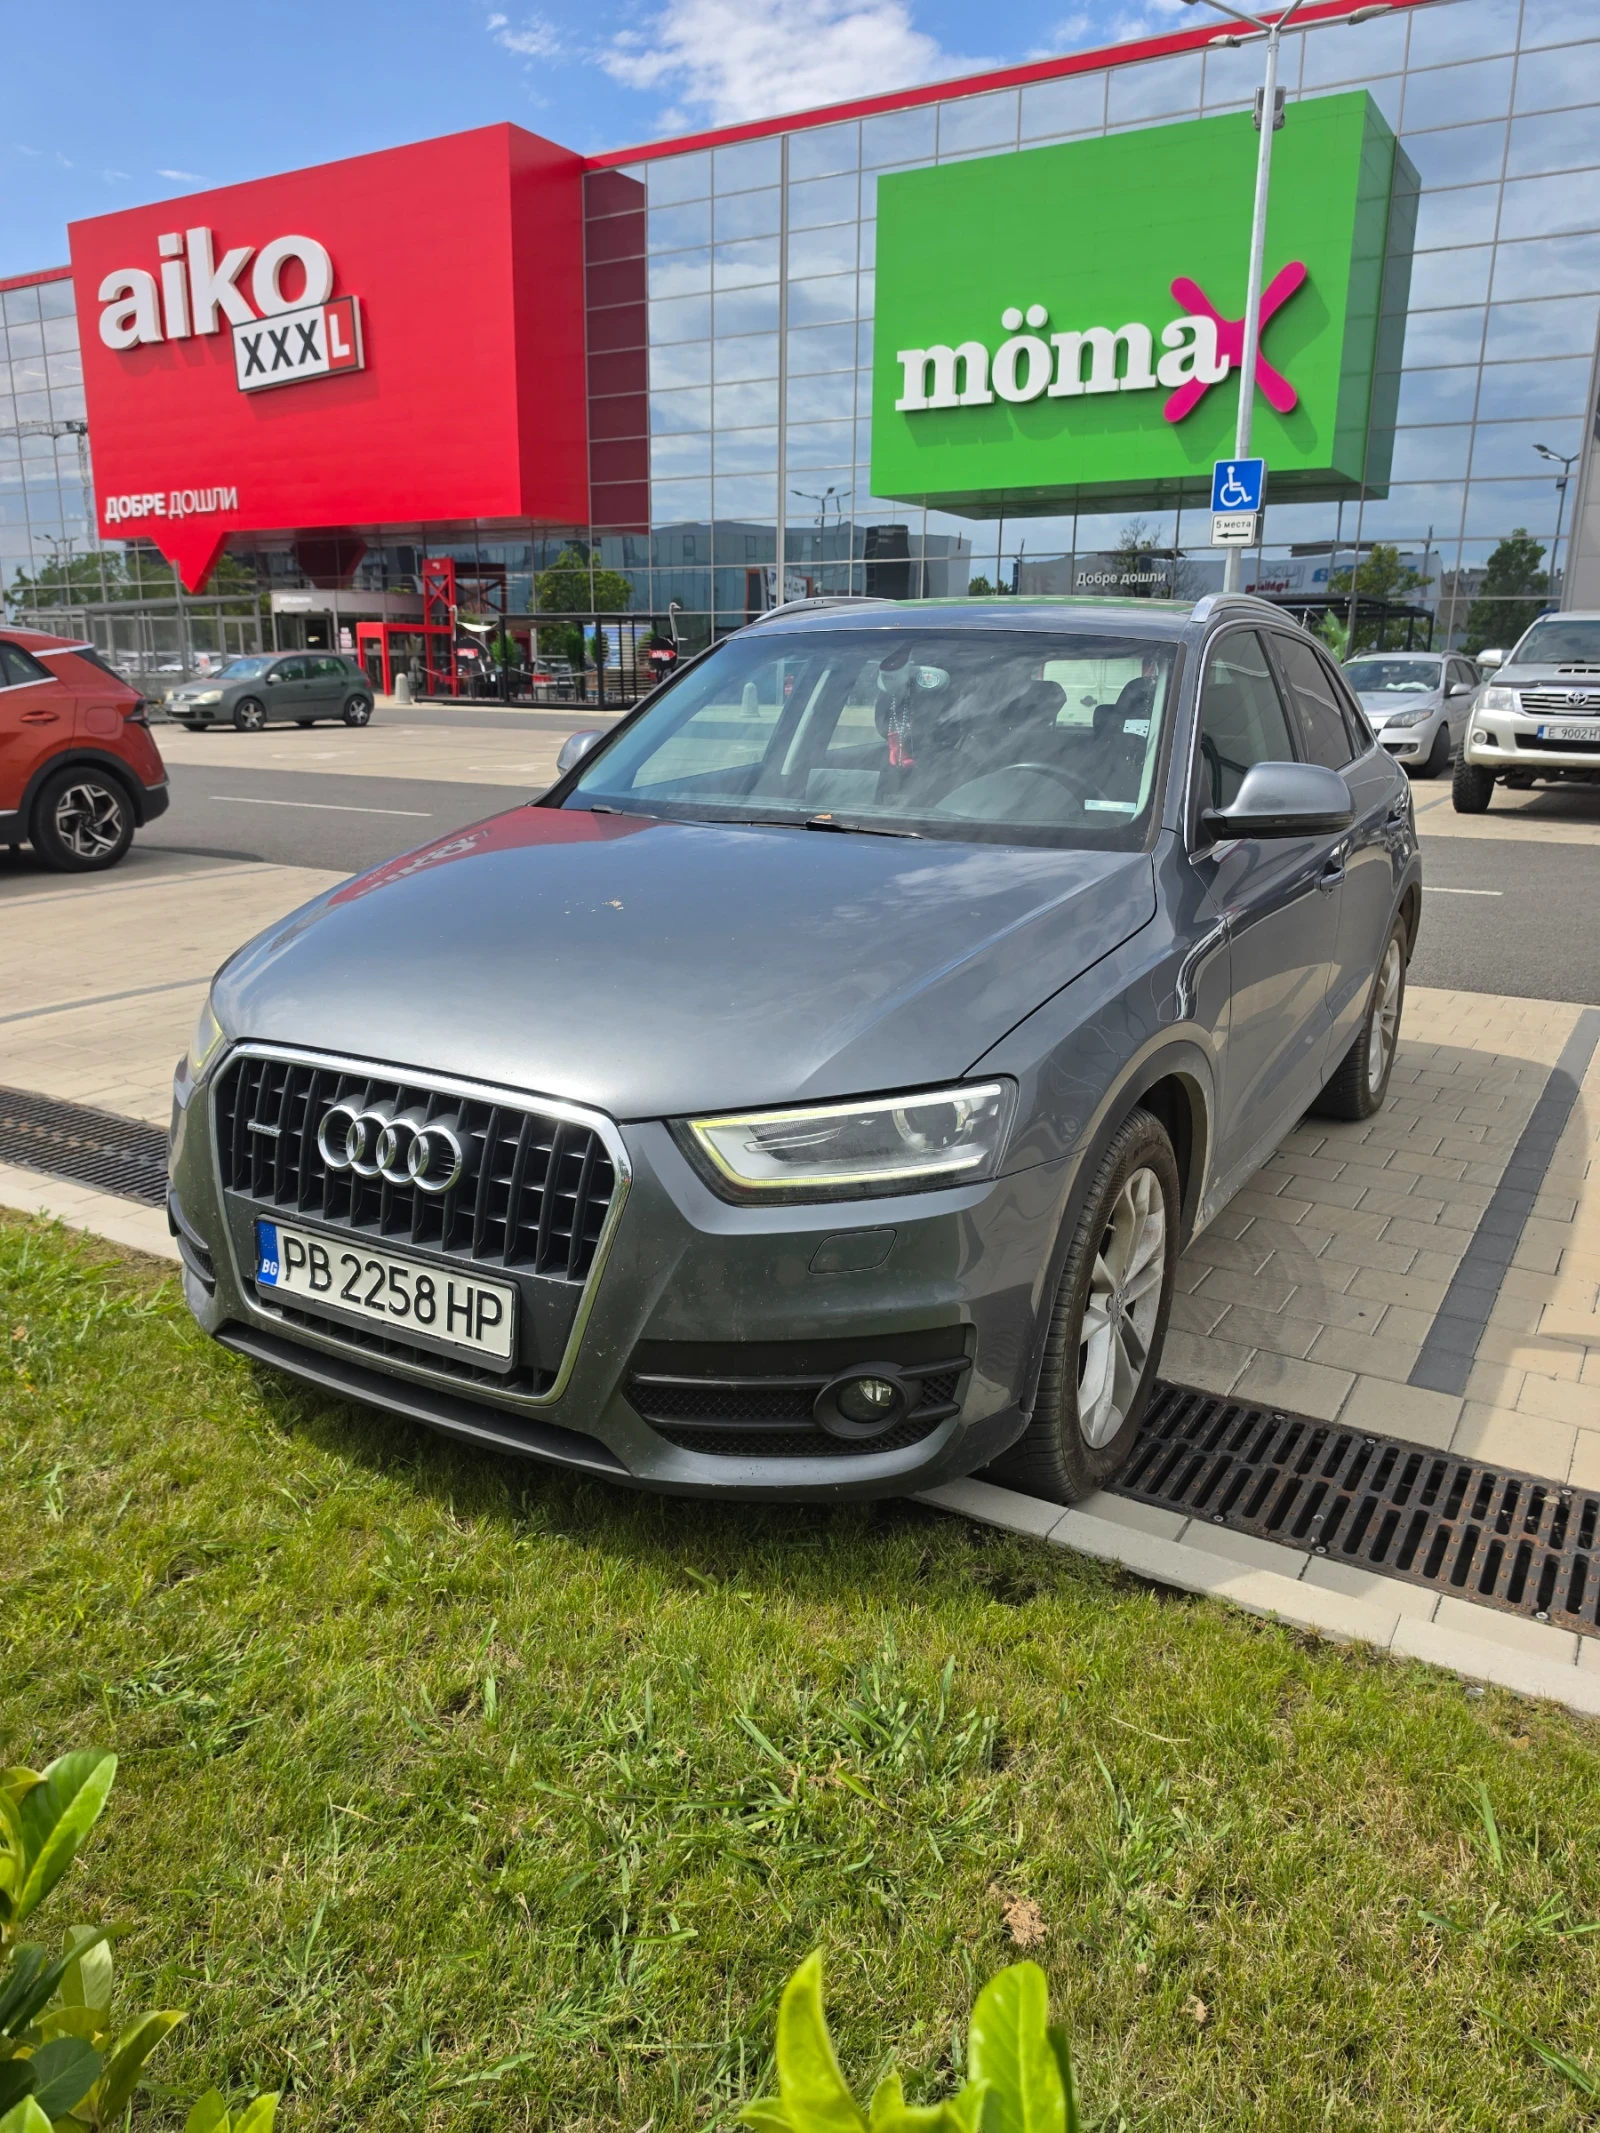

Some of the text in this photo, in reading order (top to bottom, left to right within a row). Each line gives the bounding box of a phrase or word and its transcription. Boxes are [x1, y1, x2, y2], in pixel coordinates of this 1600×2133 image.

[98, 226, 334, 350] aiko
[240, 313, 350, 378] XXXL
[895, 261, 1307, 423] mömax
[105, 486, 238, 524] ДОБРЕ ДОШЛИ
[1216, 520, 1251, 529] 5 места
[1076, 572, 1167, 587] Добре дошли
[1548, 727, 1556, 739] E
[261, 1258, 278, 1277] BG
[282, 1235, 503, 1341] PB 2258 HP
